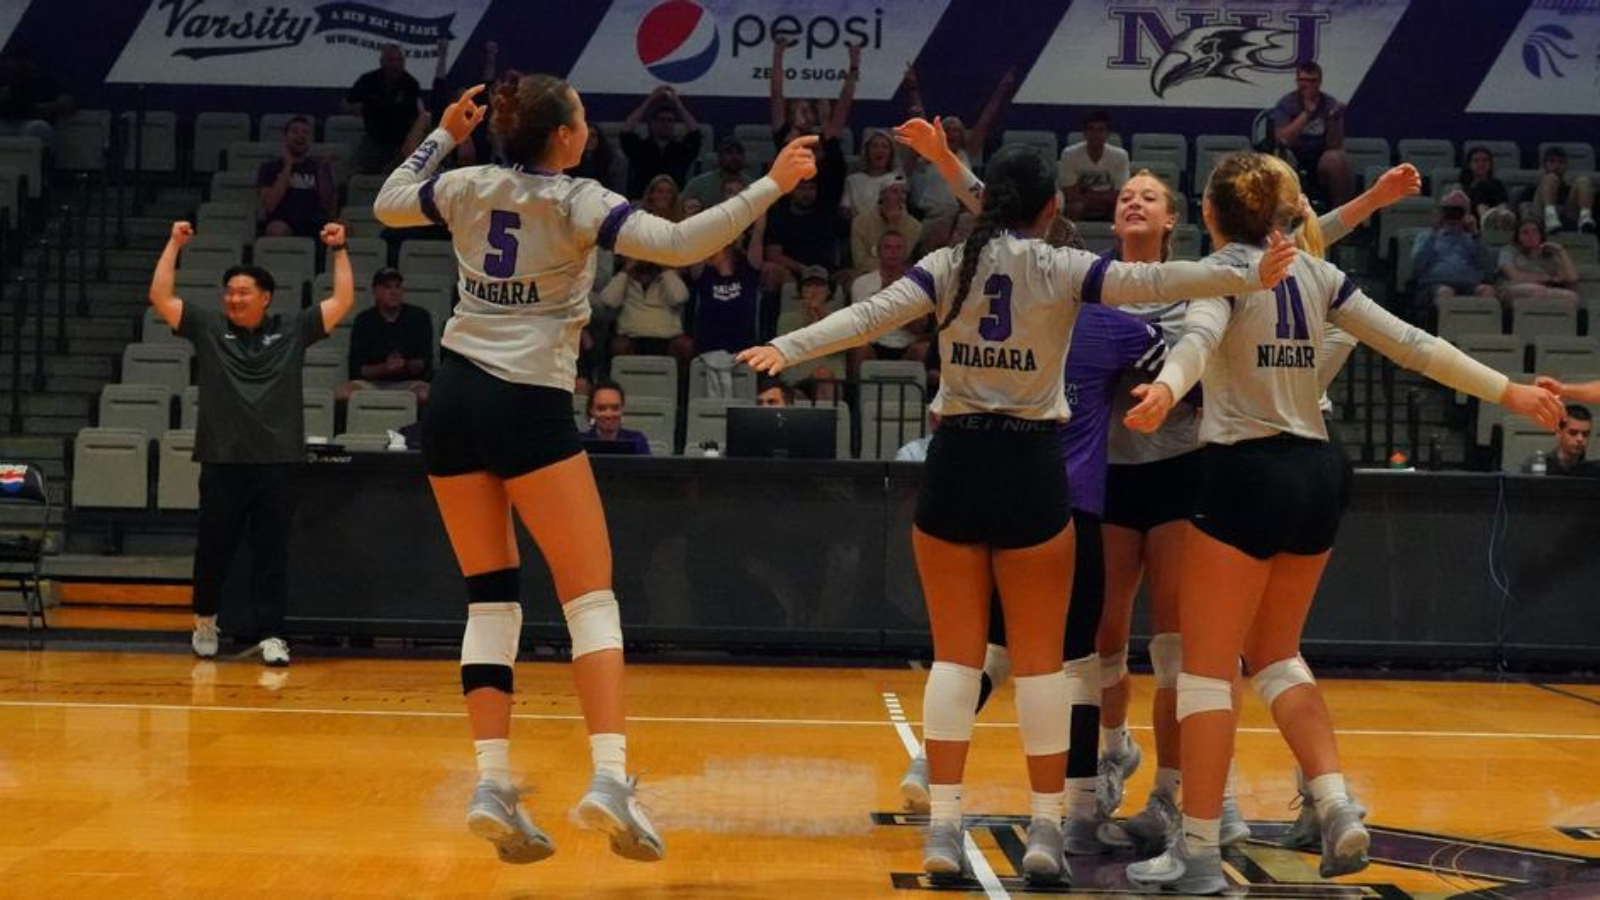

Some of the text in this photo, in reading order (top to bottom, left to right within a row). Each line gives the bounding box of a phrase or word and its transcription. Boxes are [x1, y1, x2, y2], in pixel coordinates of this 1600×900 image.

[158, 0, 313, 47] Varsity
[331, 10, 439, 36] A NEW WAY TO BANK
[732, 8, 883, 59] pepsi
[752, 67, 797, 80] ZEO
[484, 210, 521, 279] 5
[464, 277, 540, 305] NIAGARA
[978, 274, 1013, 341] 3
[1272, 276, 1310, 340] 11
[951, 342, 1037, 371] NIAGARA
[1257, 344, 1315, 369] NIAGAR
